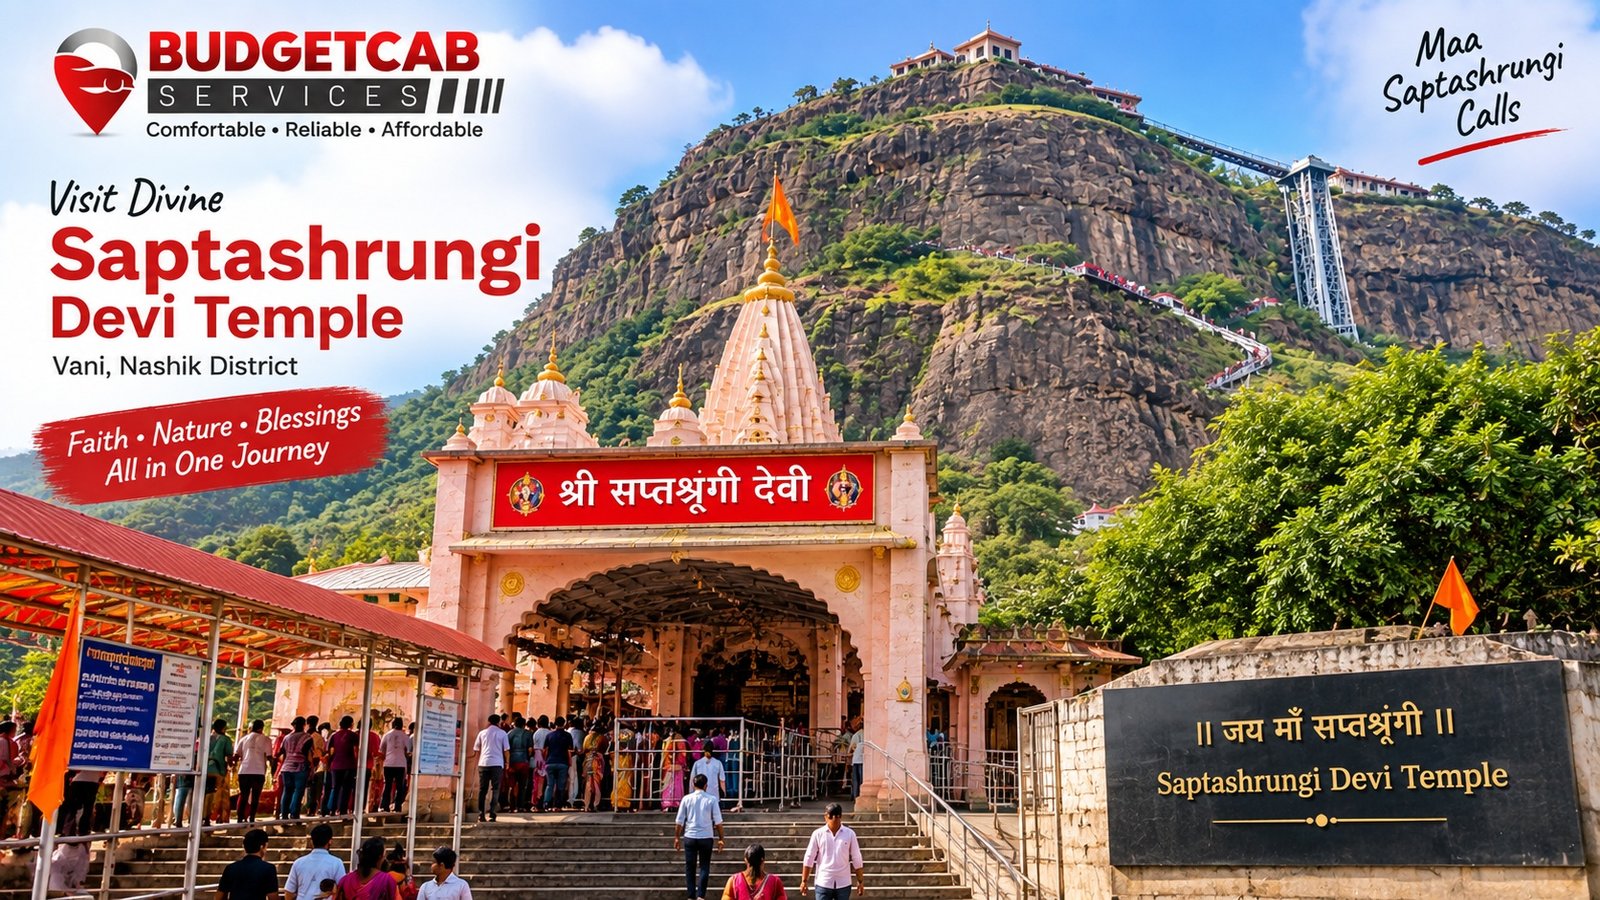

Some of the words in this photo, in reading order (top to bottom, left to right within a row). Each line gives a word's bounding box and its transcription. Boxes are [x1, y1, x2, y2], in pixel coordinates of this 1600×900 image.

[558, 469, 599, 506] श्री
[752, 464, 812, 504] देवी
[1221, 719, 1265, 743] जय
[1272, 706, 1303, 741] माँ
[1157, 767, 1321, 801] Saptashrungi
[1329, 764, 1392, 791] Devi
[1400, 760, 1509, 795] Temple
